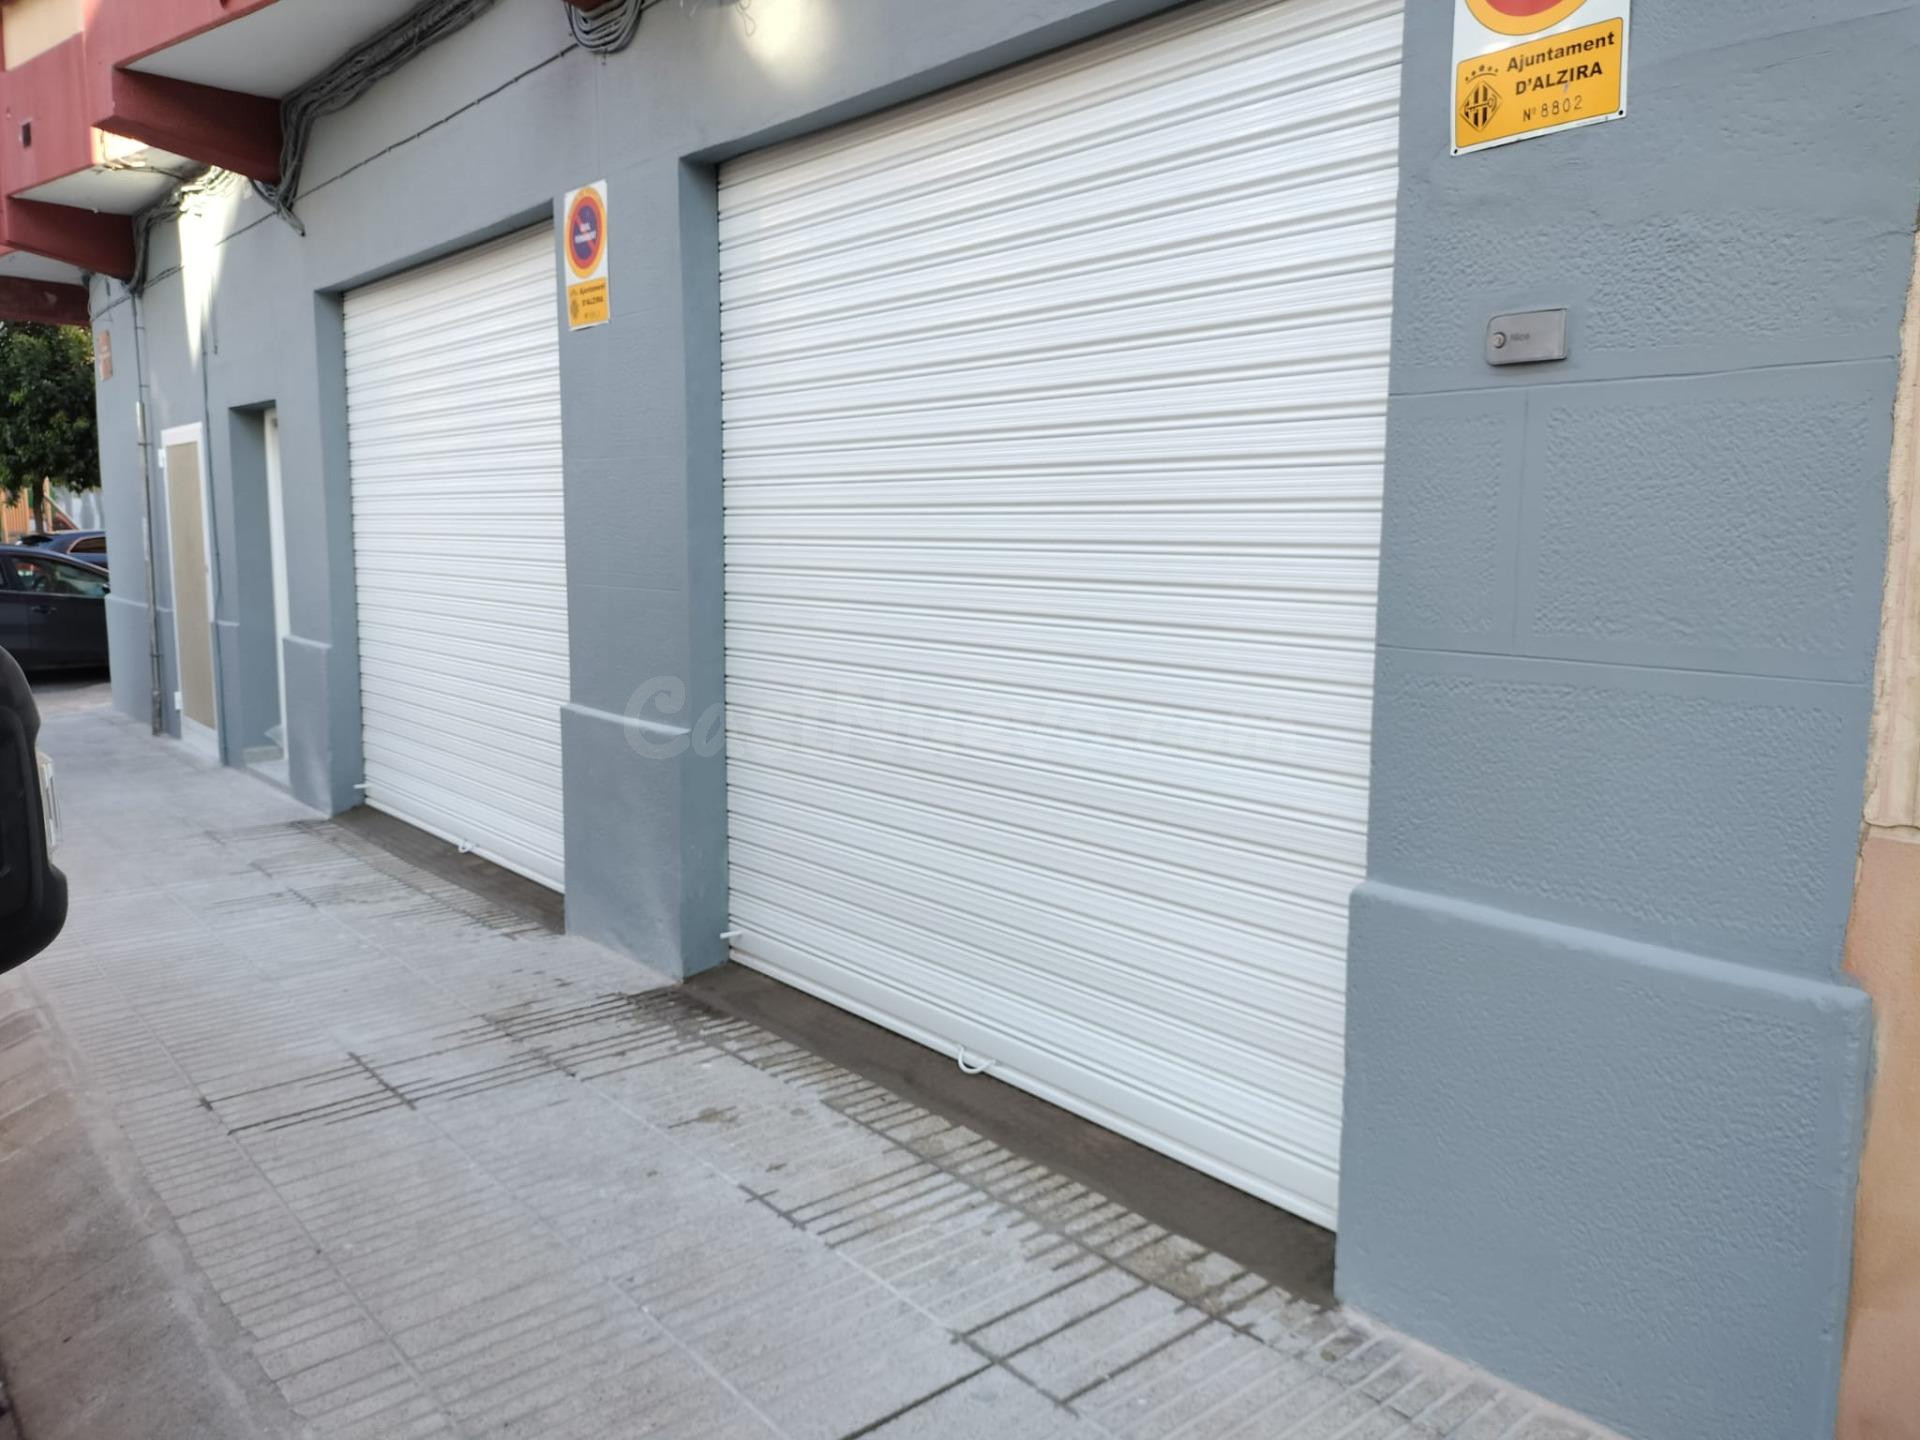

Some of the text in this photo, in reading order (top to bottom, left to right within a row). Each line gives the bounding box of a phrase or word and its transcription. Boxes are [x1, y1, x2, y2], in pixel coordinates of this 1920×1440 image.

[1507, 32, 1614, 72] Ajuntament
[1515, 61, 1602, 96] D'ALZIRA
[1541, 95, 1582, 118] 8802
